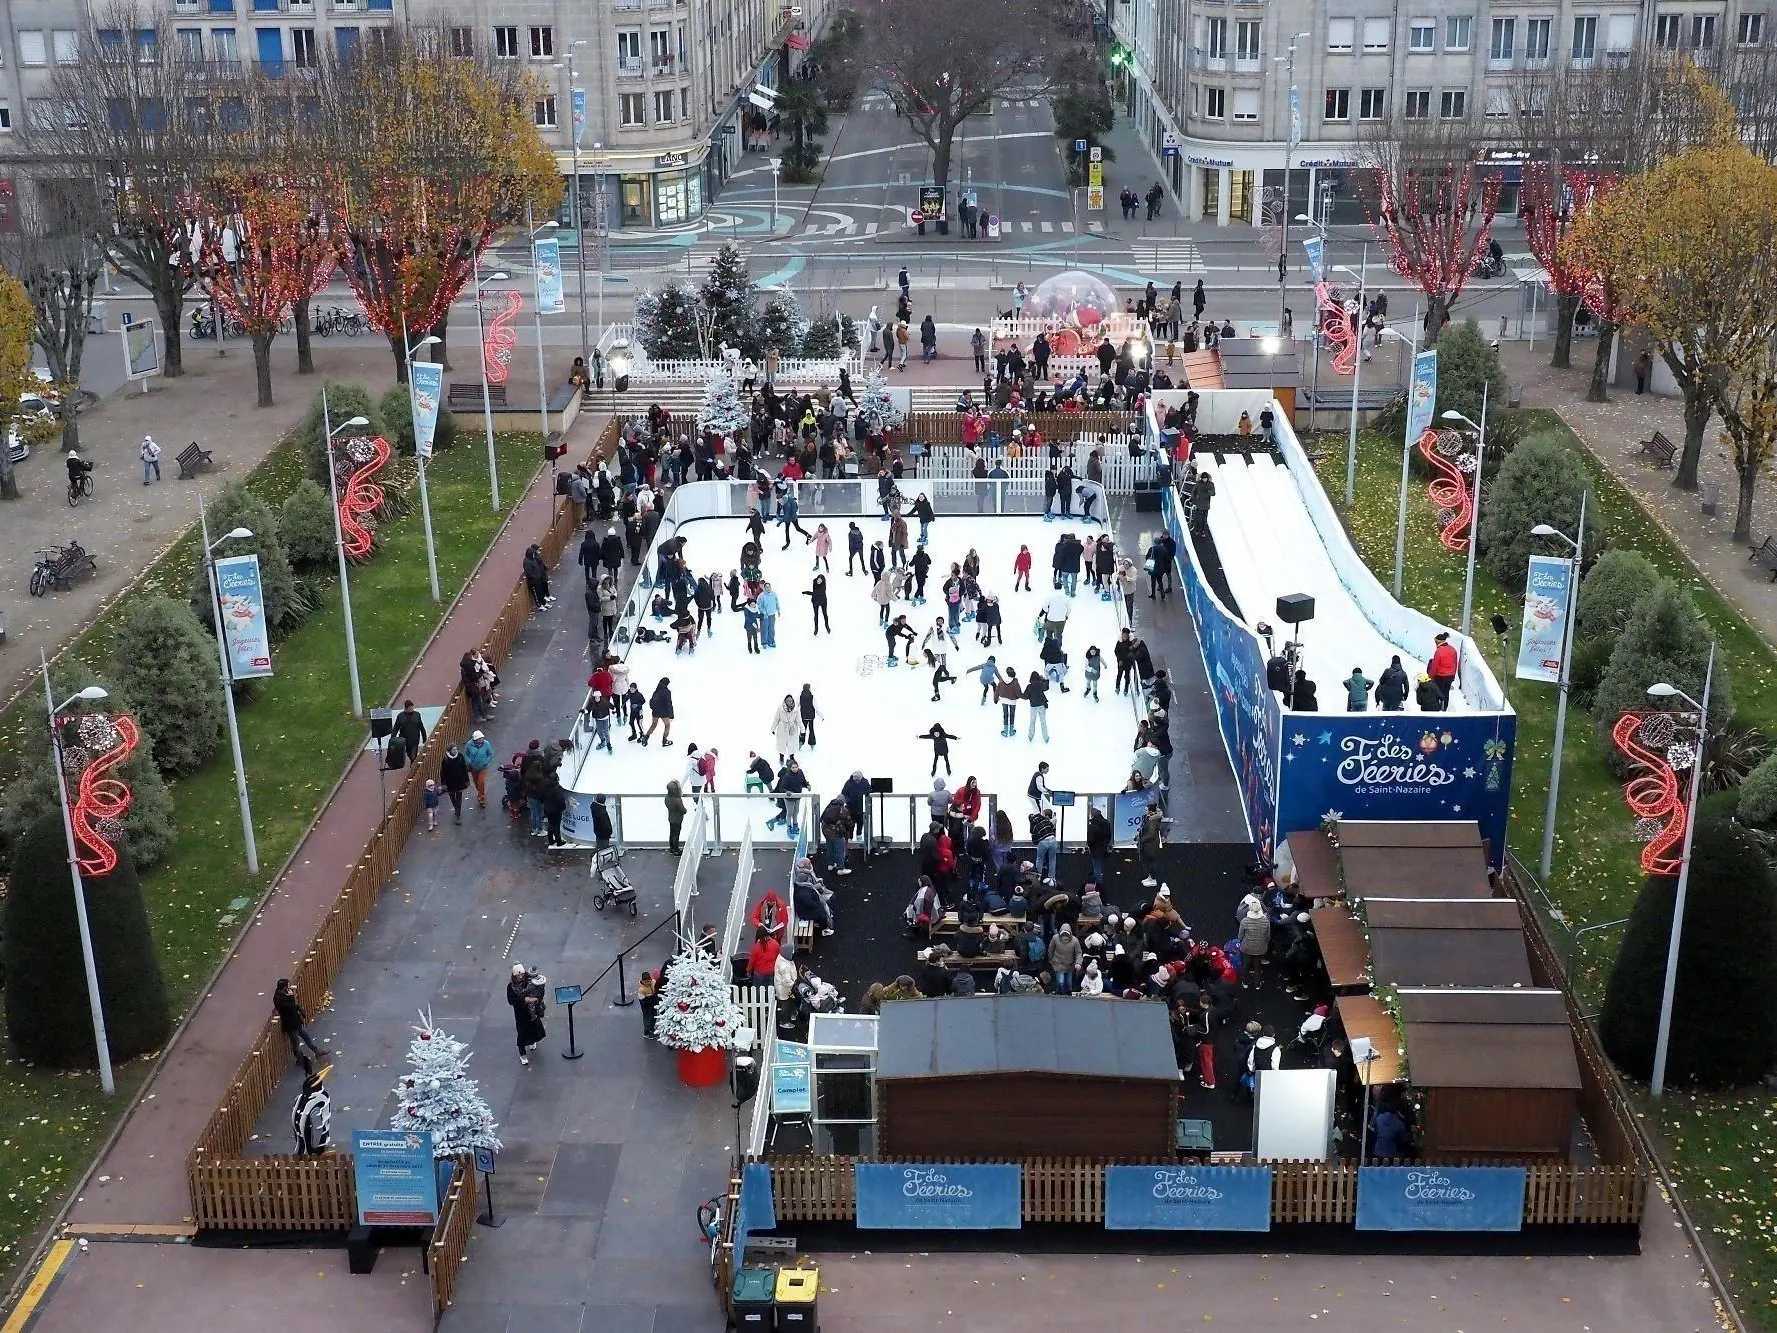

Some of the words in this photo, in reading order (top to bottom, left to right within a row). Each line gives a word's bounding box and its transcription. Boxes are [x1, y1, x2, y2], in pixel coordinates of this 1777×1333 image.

[1209, 156, 1234, 167] Mutuel
[1300, 159, 1324, 168] Crédit
[1333, 159, 1359, 168] Mutuel
[1377, 734, 1413, 760] Les
[1337, 735, 1455, 786] Féeries
[1355, 785, 1367, 794] de
[1369, 785, 1432, 794] Saint-Nazaire
[902, 1168, 973, 1198] Féeries
[925, 1168, 947, 1183] Les
[1175, 1170, 1197, 1185] Les
[1429, 1171, 1450, 1186] Les
[1153, 1170, 1223, 1199] Féeries
[1404, 1171, 1475, 1200] Féeries
